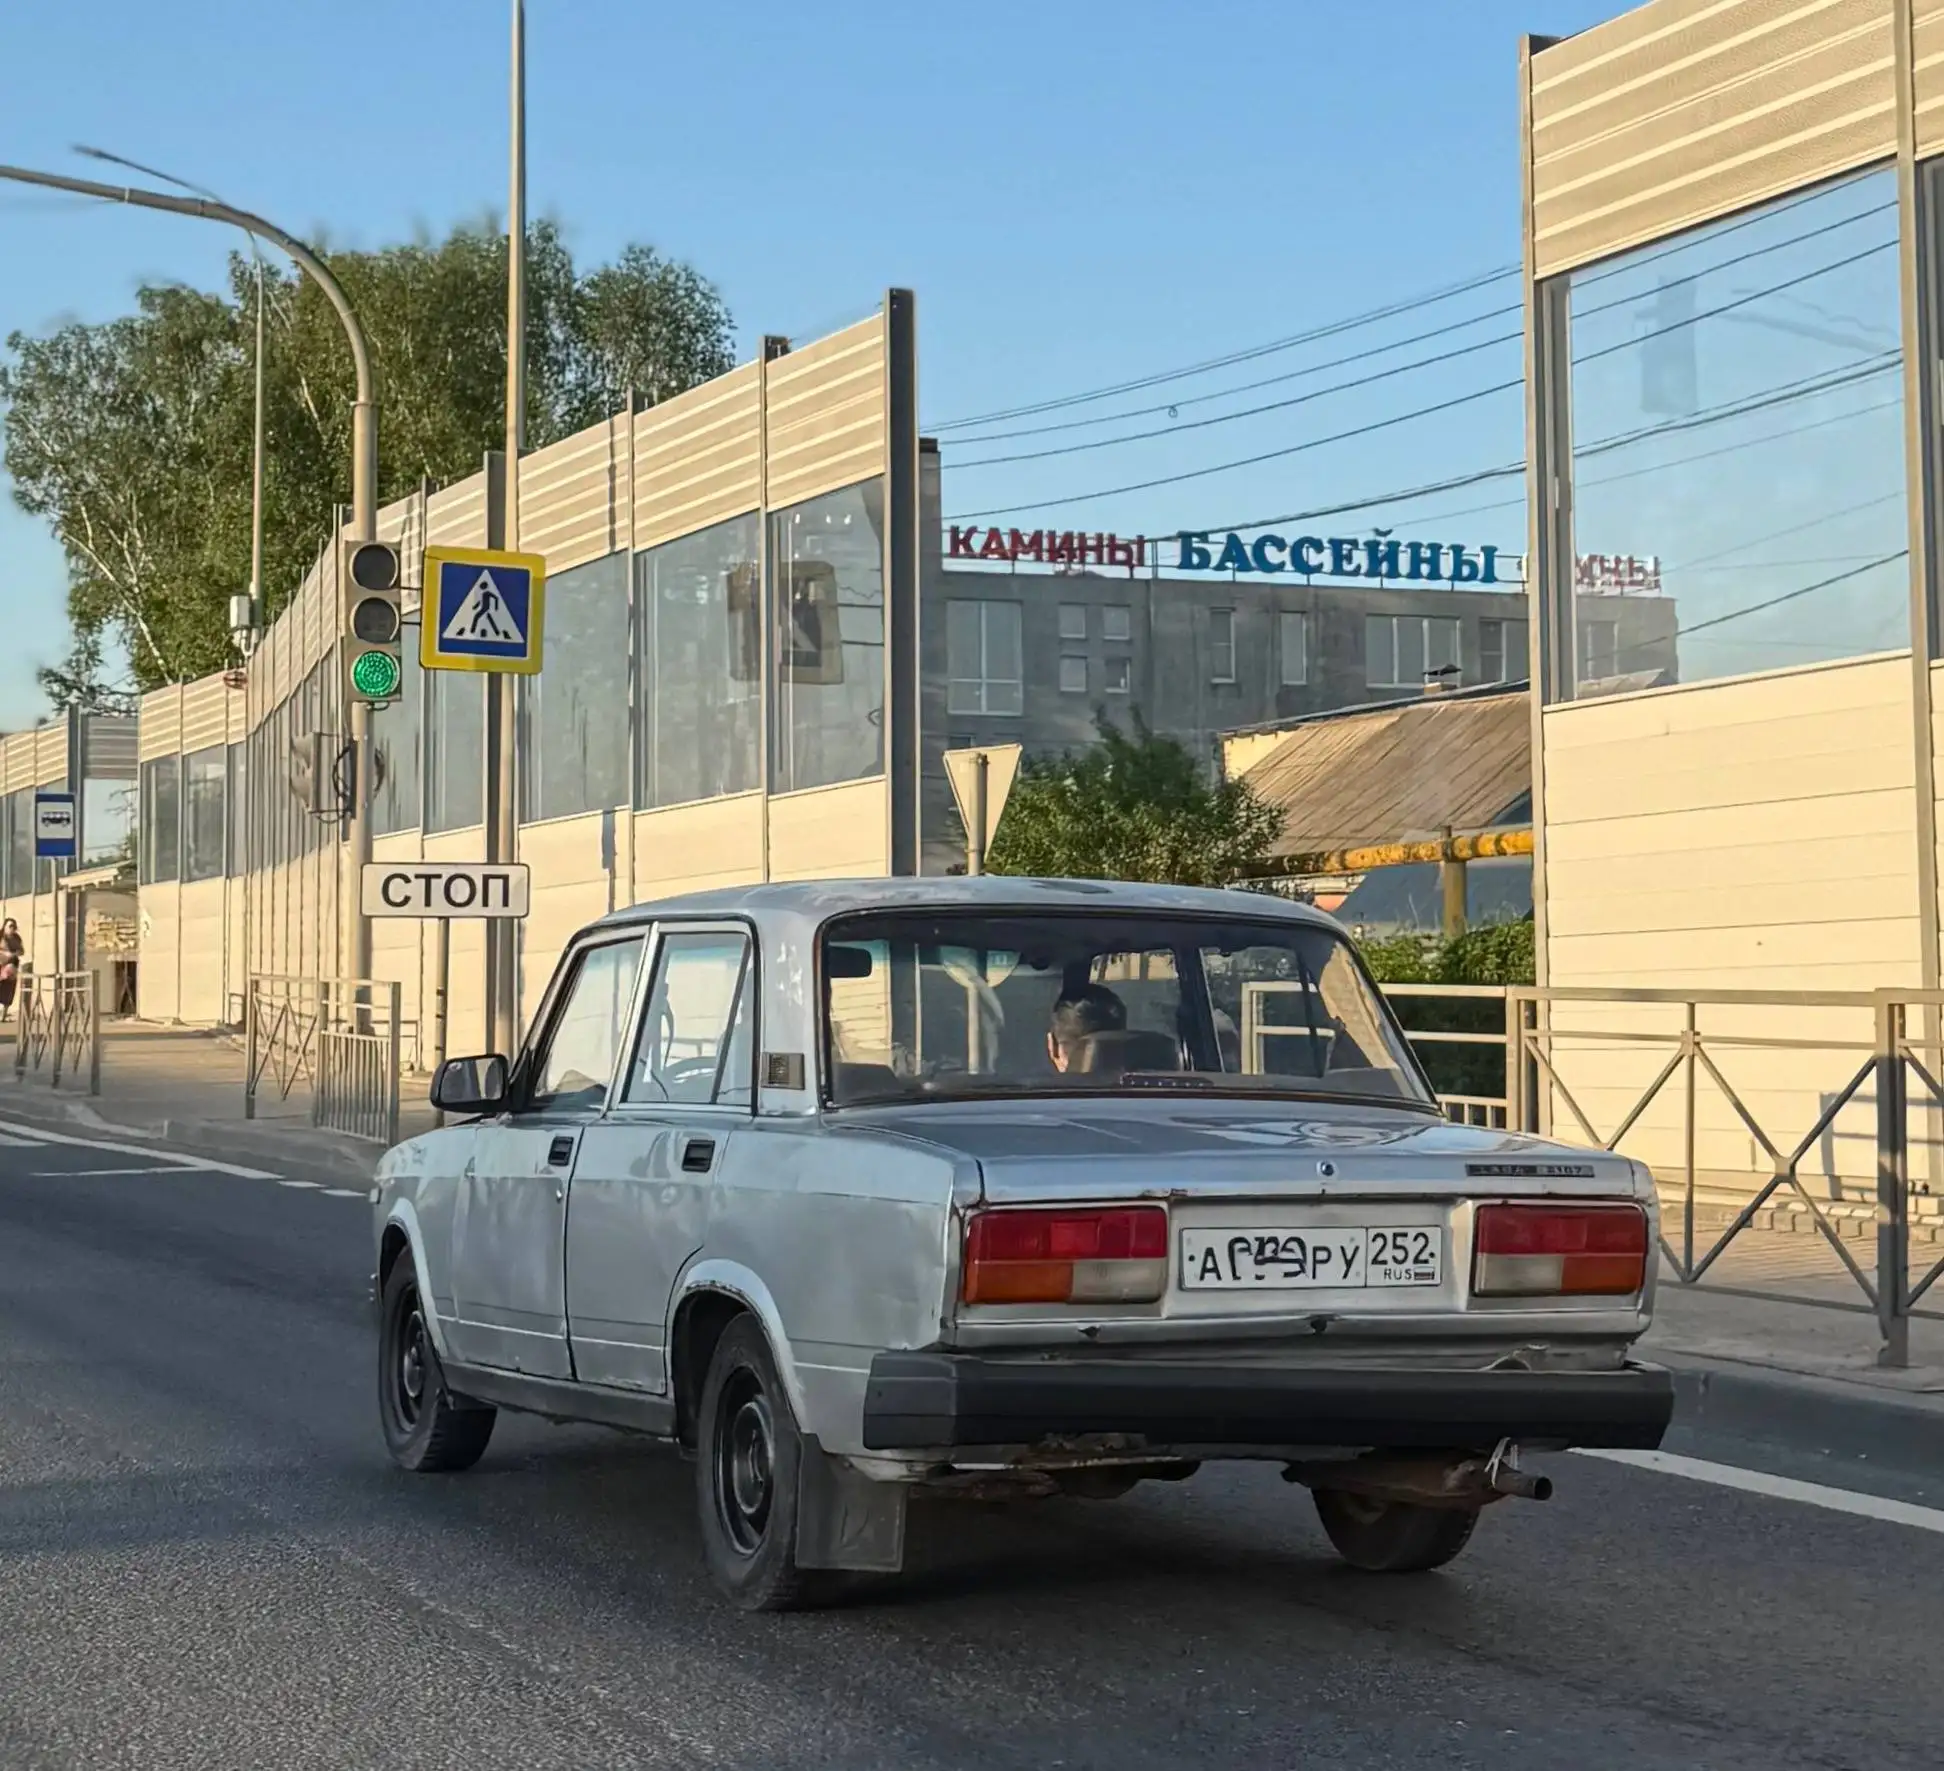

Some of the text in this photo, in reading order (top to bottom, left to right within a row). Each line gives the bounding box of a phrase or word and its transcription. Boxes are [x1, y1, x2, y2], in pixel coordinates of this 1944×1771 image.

[950, 525, 1145, 566] КАМИНЫ
[1177, 527, 1499, 583] БАССЕЙНЫ
[382, 873, 509, 908] СТОП
[1371, 1232, 1429, 1265] 252
[1383, 1268, 1412, 1280] RUS
